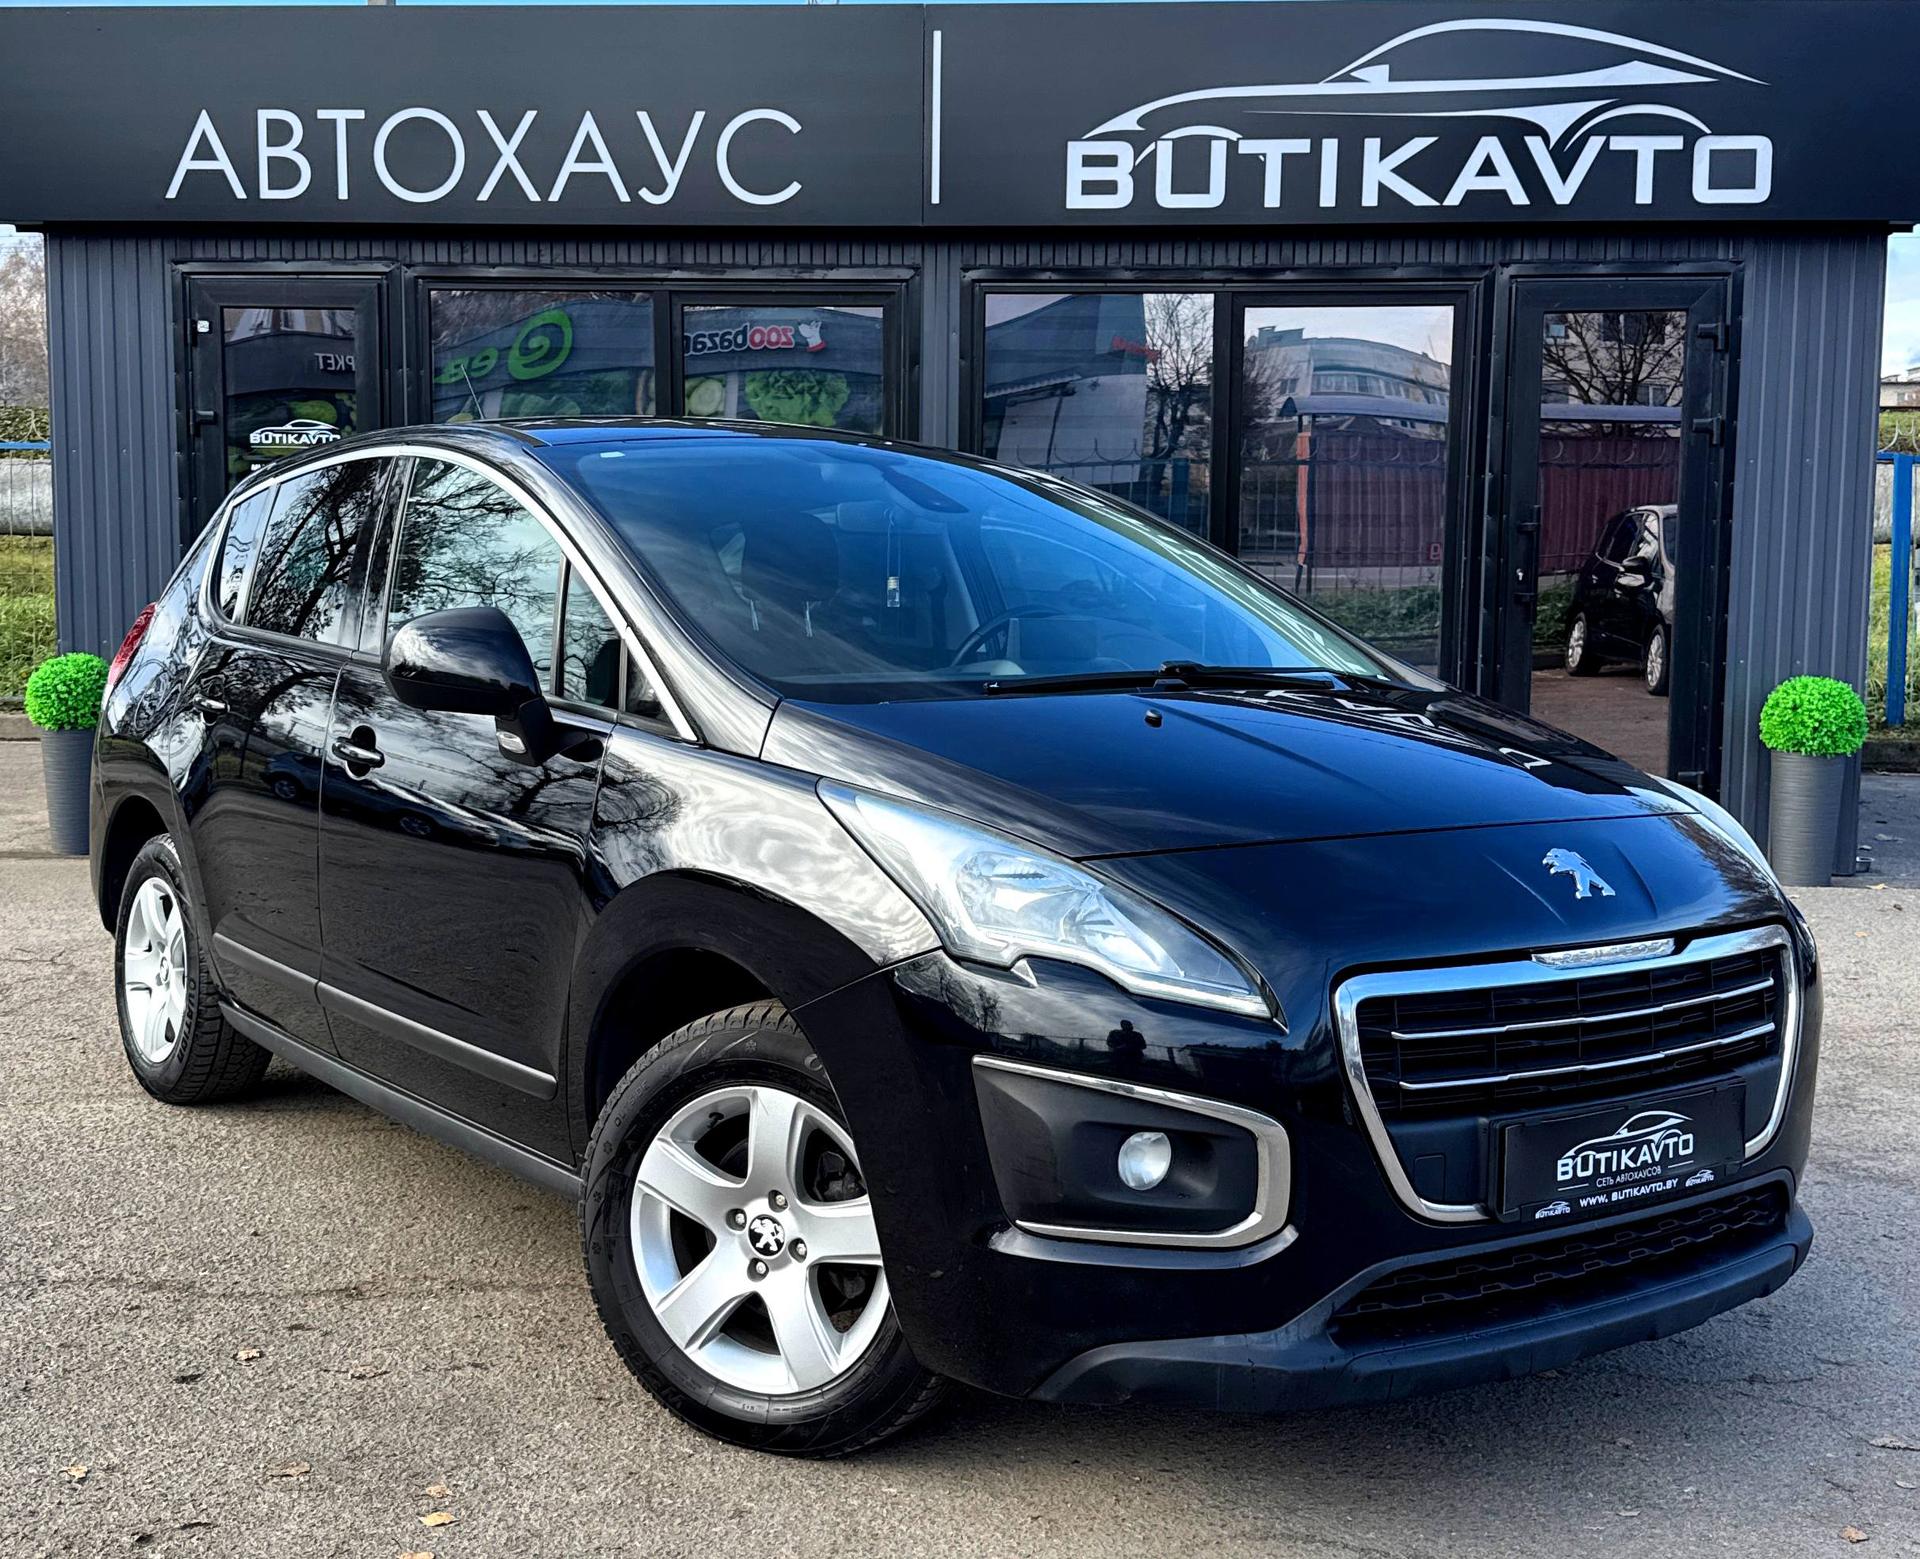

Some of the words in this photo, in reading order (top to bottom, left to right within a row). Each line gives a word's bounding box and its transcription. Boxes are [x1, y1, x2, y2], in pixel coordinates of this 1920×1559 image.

[165, 107, 804, 206] АВТОХАУС
[1065, 133, 1773, 210] BUTIKAVTO
[1557, 1133, 1694, 1182] BUTIKAVTO
[1596, 1177, 1615, 1188] СЕТЬ
[1615, 1165, 1662, 1184] АВТОХАУСОВ
[1579, 1195, 1609, 1209] WWW.
[1611, 1178, 1679, 1202] BUTIKAVTO.BY
